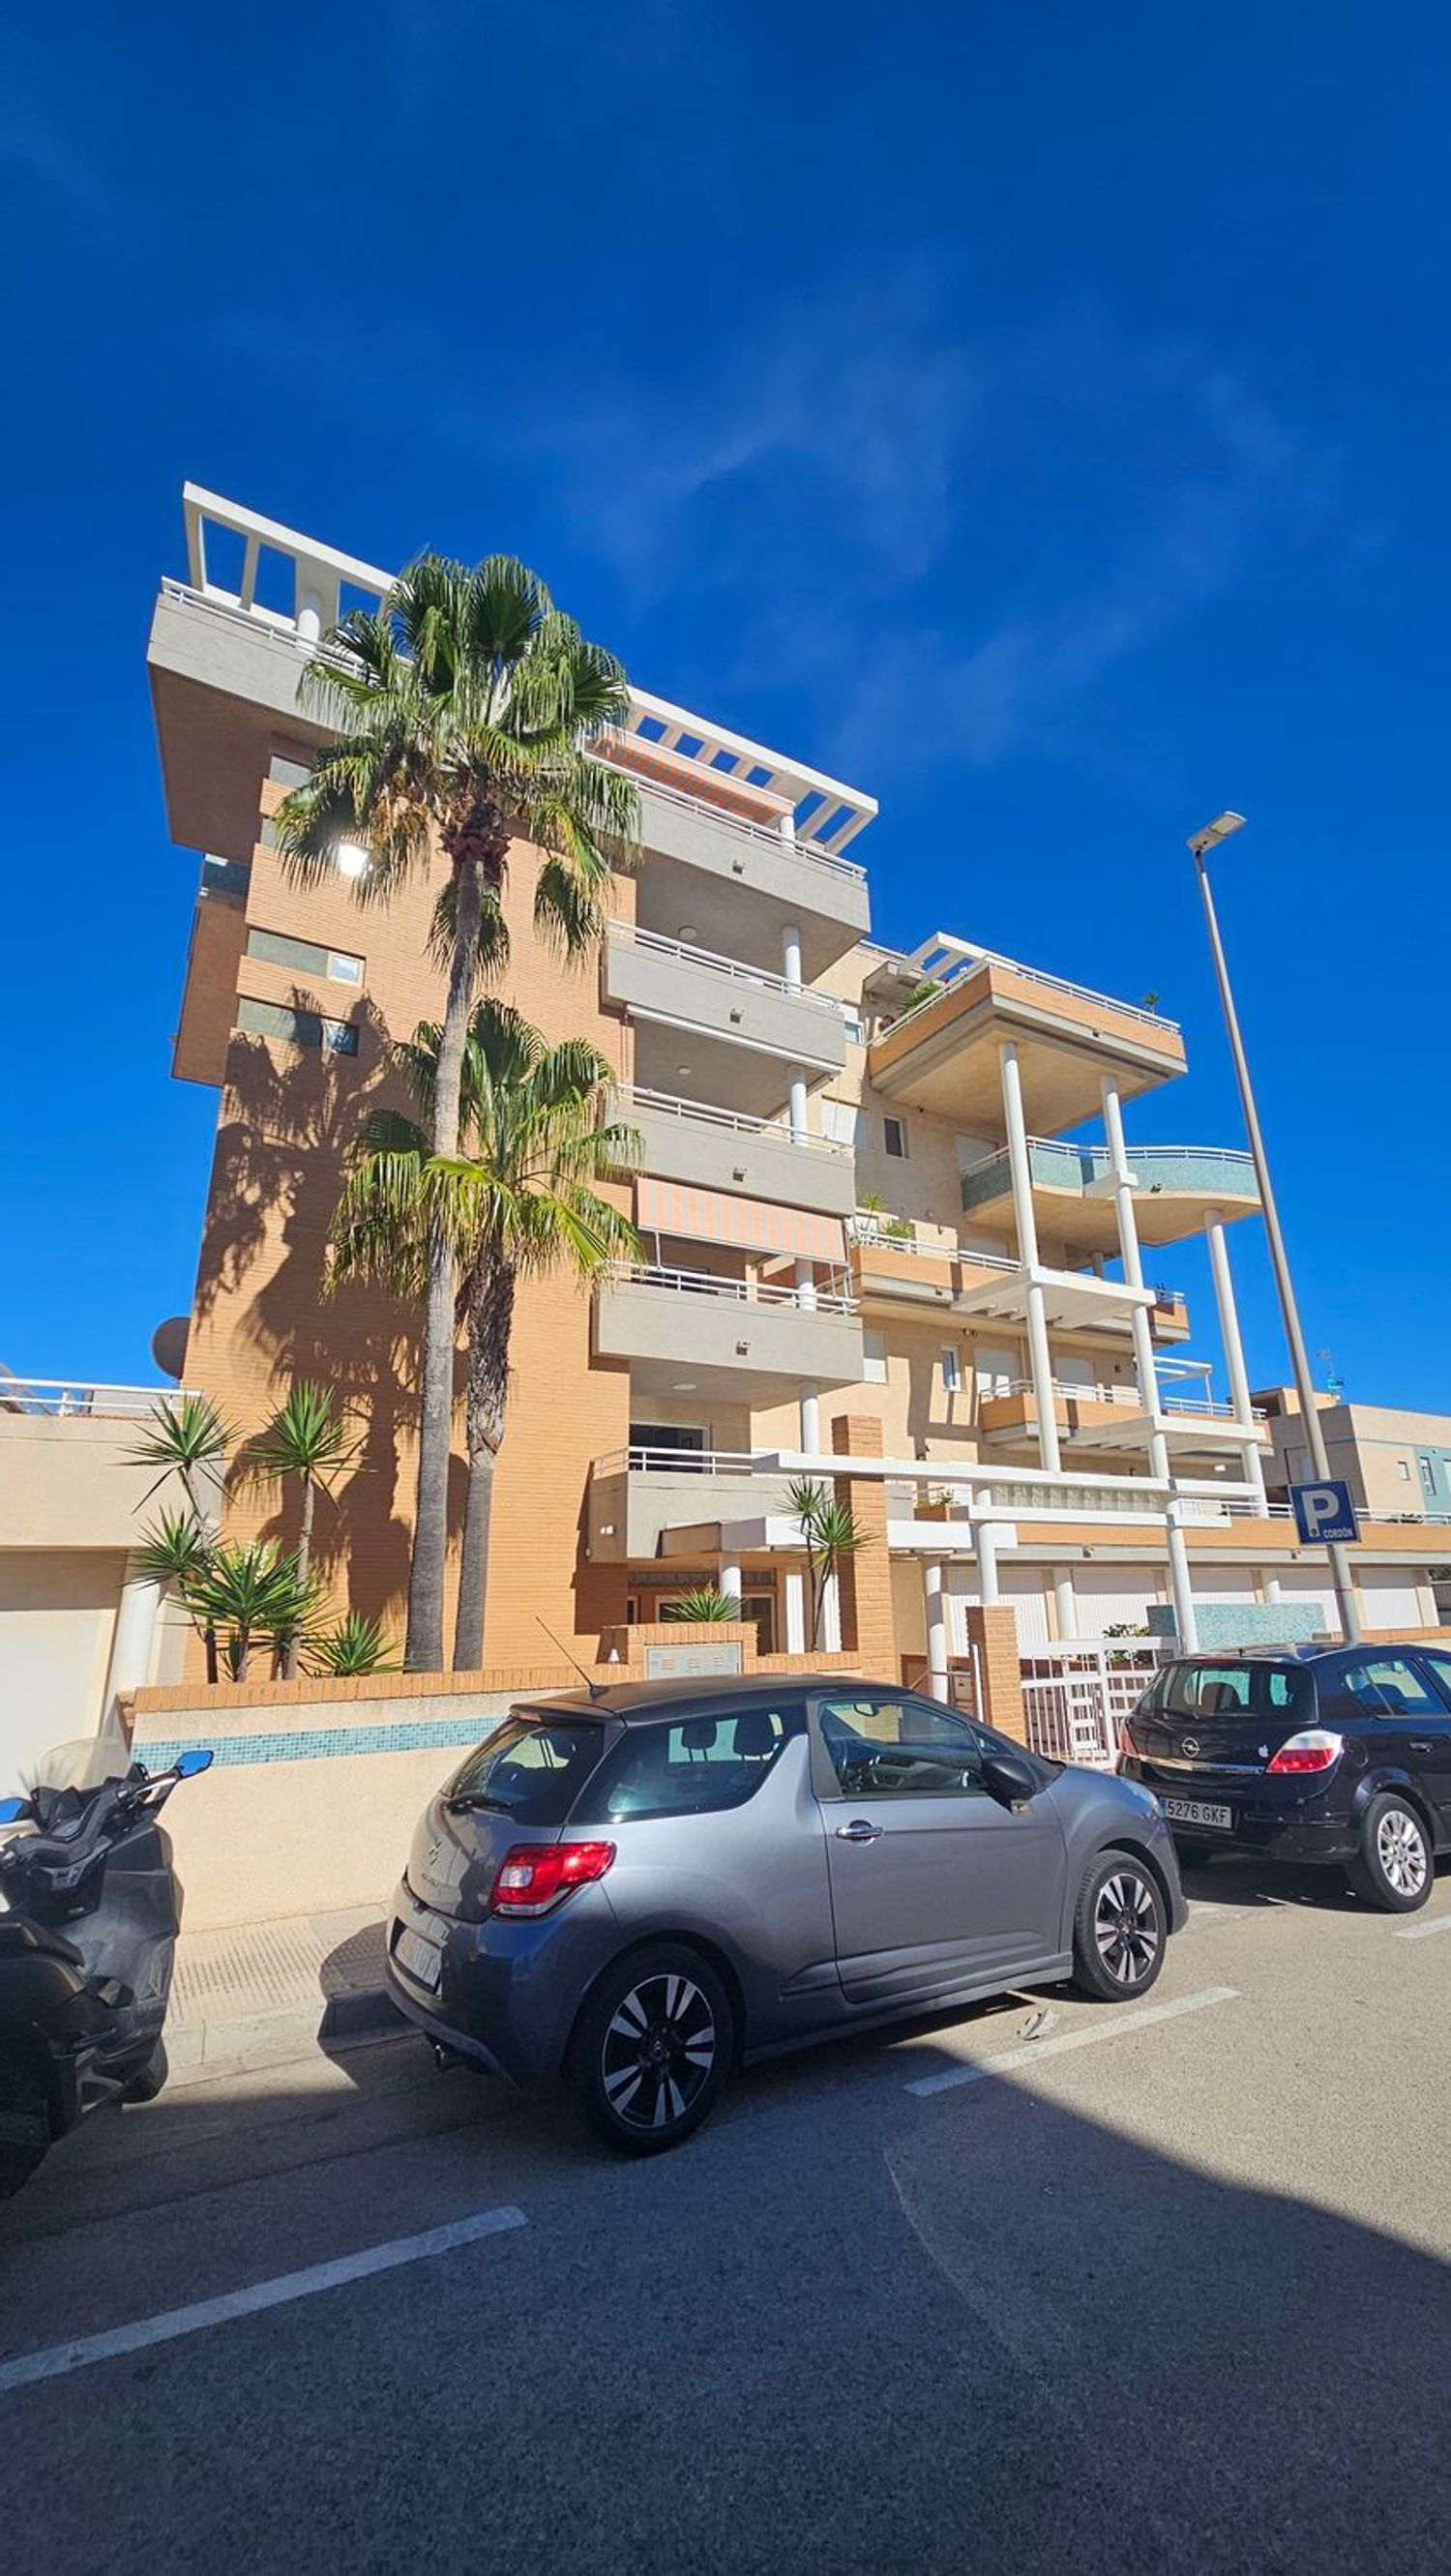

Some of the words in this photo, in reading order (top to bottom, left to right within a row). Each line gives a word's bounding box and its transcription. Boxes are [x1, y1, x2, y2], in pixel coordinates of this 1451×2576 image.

[1301, 1490, 1339, 1537] P
[1168, 1801, 1199, 1820] 5276
[1202, 1806, 1228, 1823] GKF
